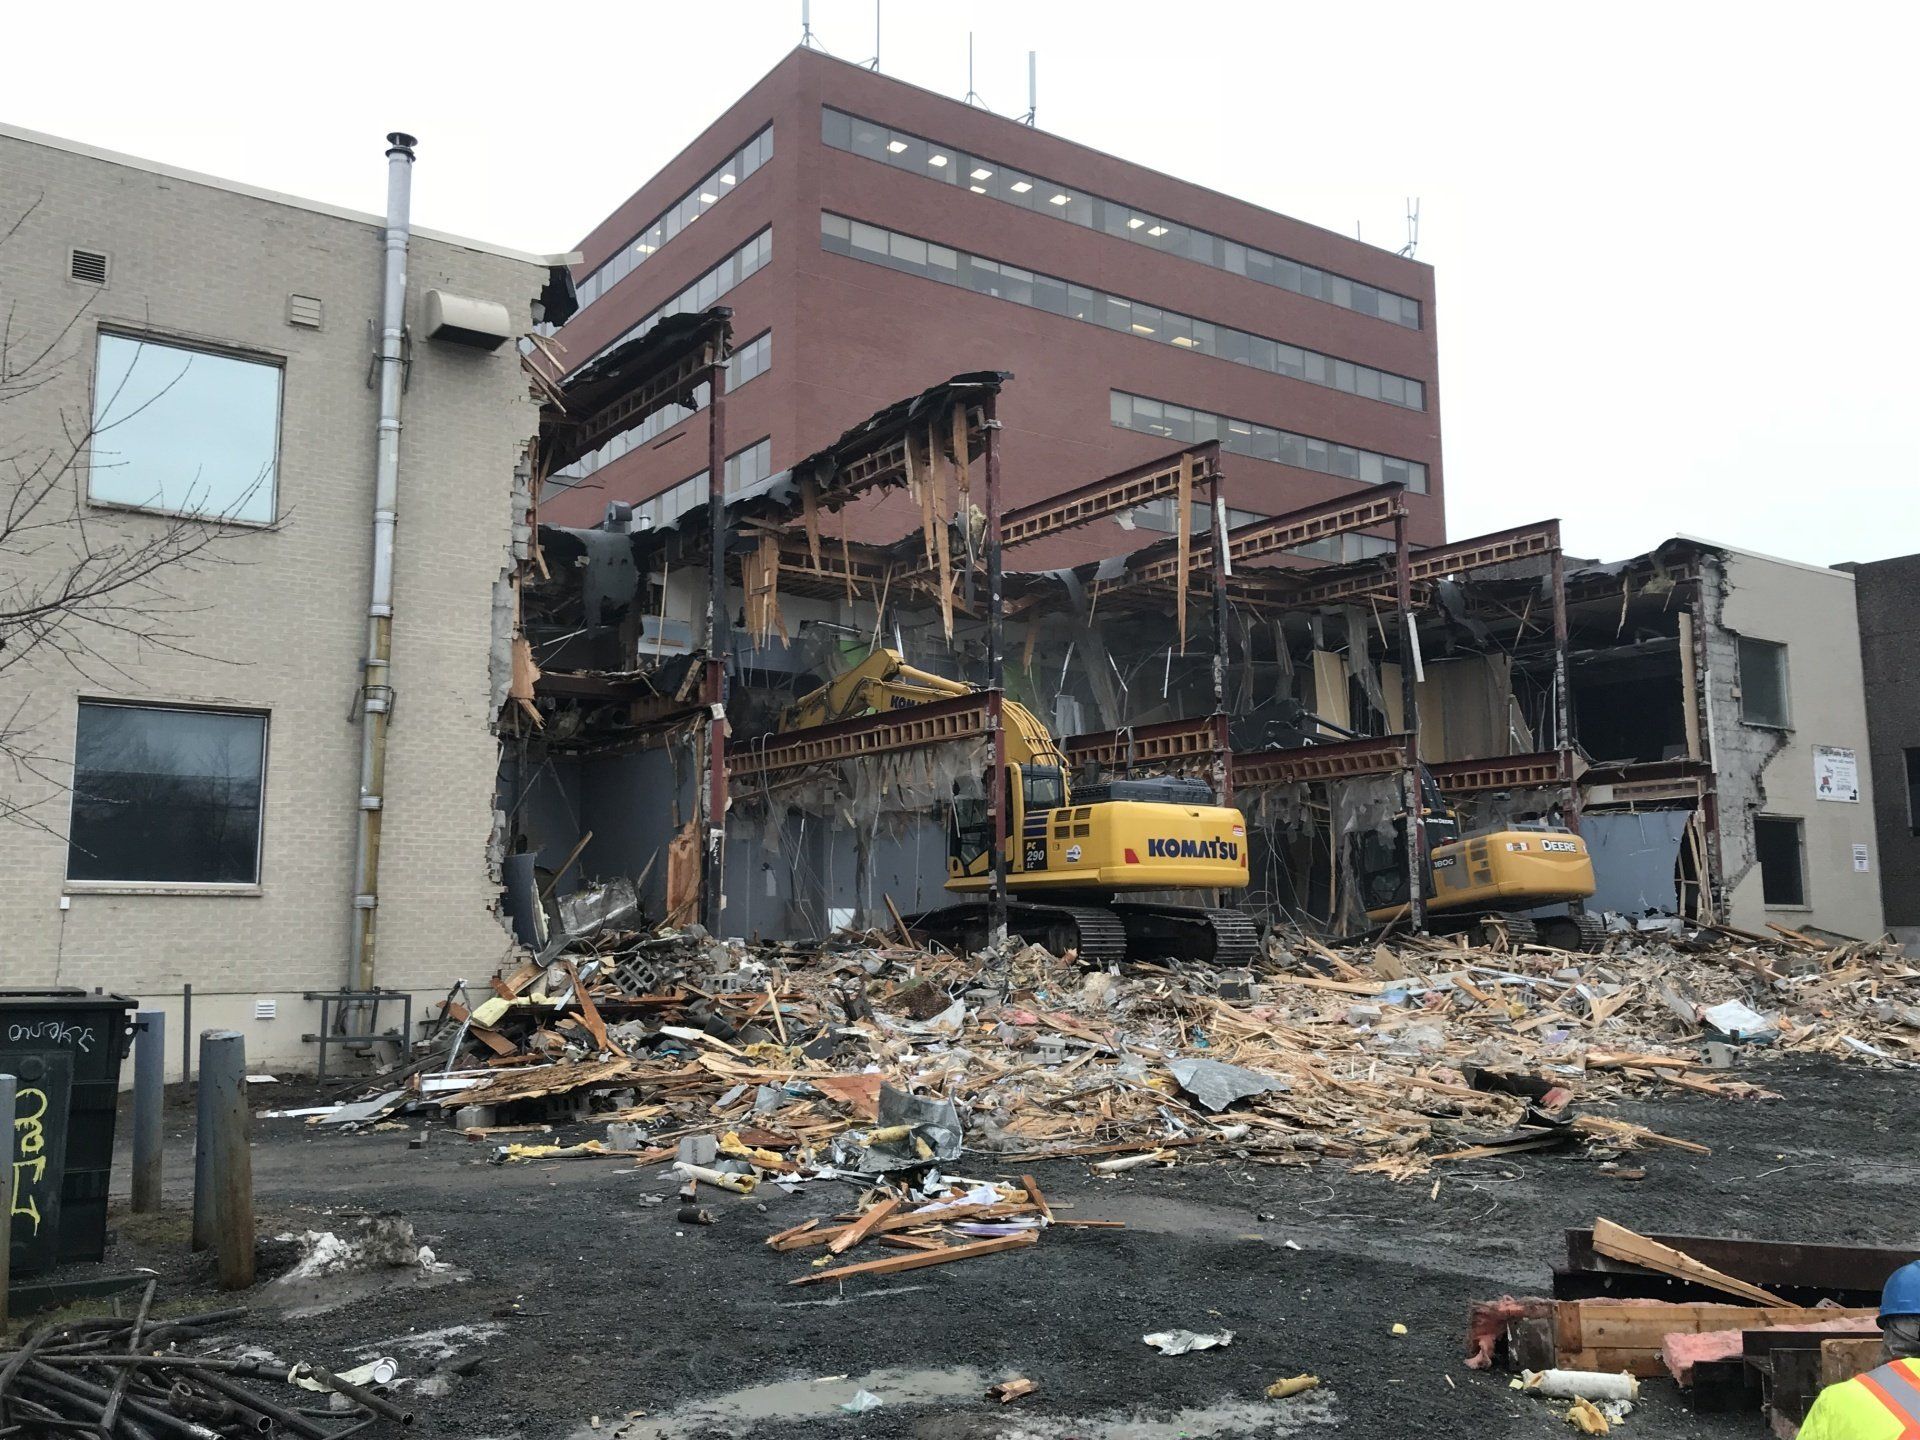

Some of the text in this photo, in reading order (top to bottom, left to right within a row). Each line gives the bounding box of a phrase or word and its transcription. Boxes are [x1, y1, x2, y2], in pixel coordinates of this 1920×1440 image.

[1026, 841, 1037, 850] PC
[1148, 836, 1238, 860] KOMATSU
[1541, 839, 1577, 852] DEERE
[1026, 850, 1045, 861] 290
[1026, 861, 1035, 869] LC
